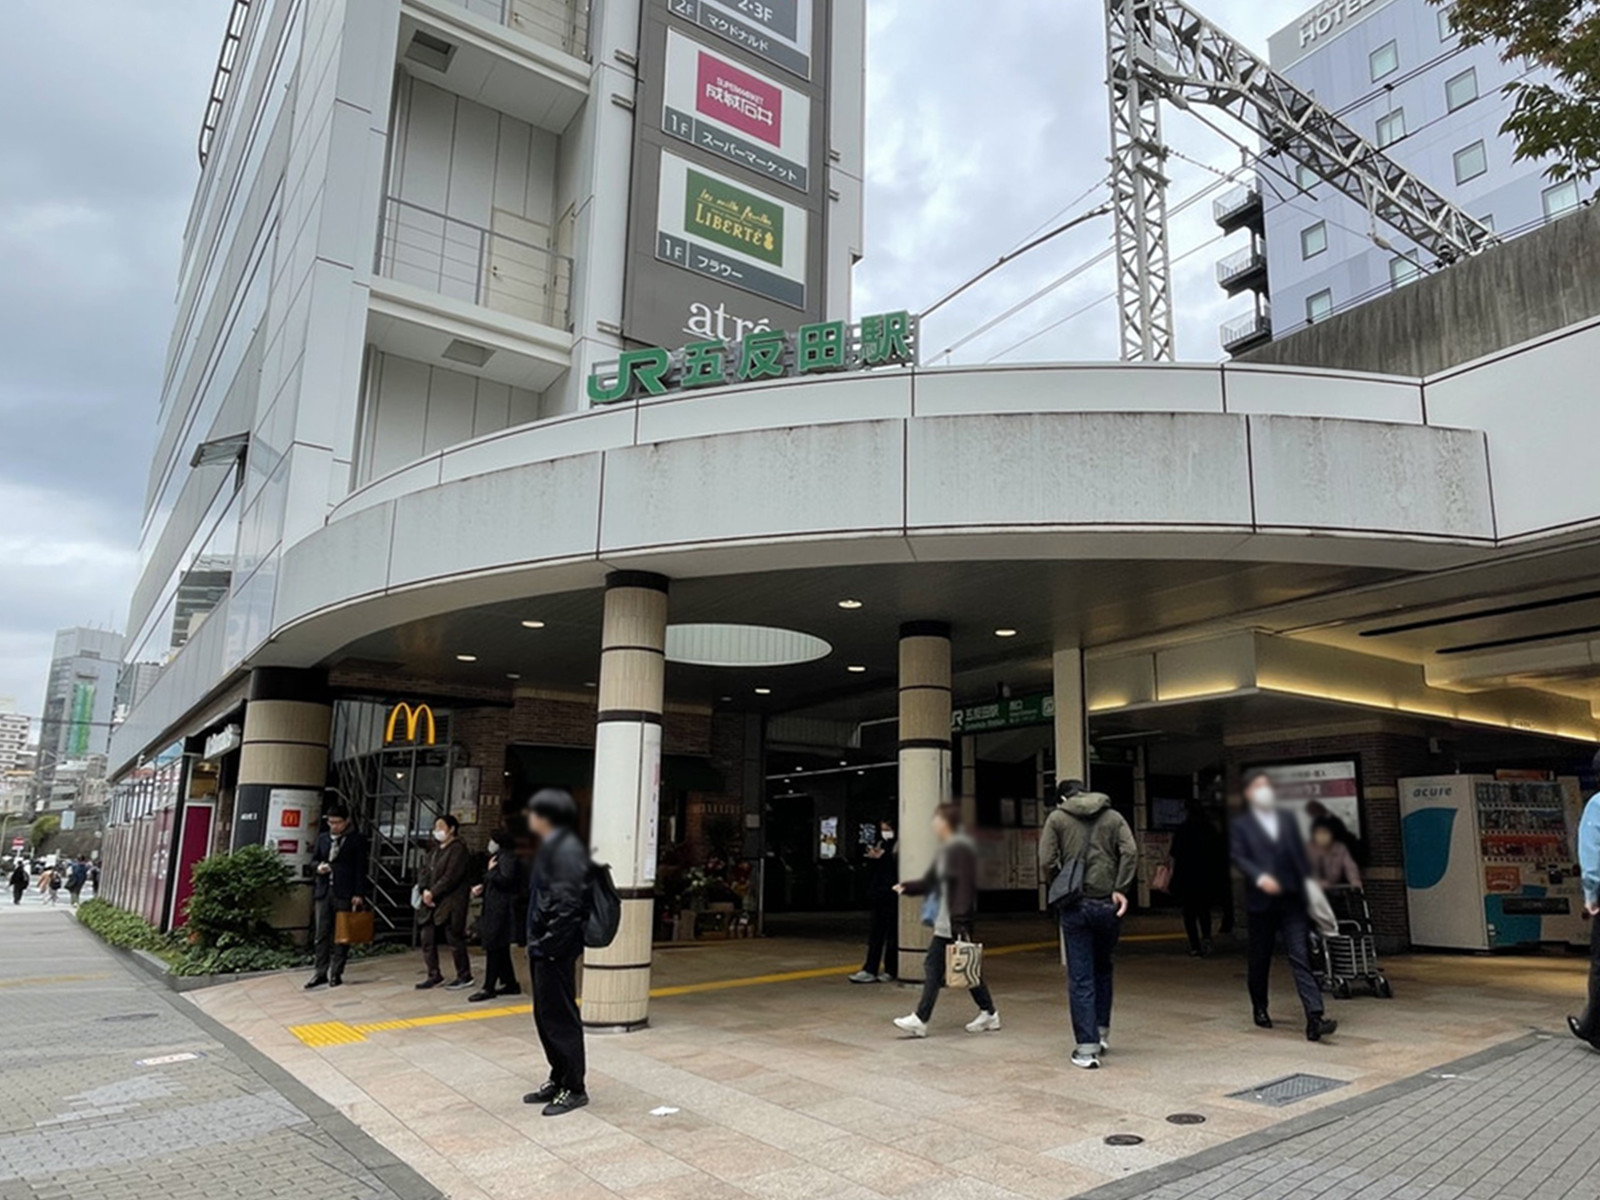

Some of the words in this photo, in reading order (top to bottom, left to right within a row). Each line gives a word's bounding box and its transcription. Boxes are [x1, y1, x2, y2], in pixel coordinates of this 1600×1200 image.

[675, 0, 695, 15] 2F
[707, 13, 769, 51] マクドナルド
[706, 83, 773, 126] 成城石井
[671, 114, 689, 134] 1F
[702, 131, 797, 181] スーパーマーケット
[695, 202, 763, 246] LIBERTÉ
[665, 239, 683, 259] 1F
[697, 255, 743, 279] フラワー
[1413, 787, 1452, 798] acure
